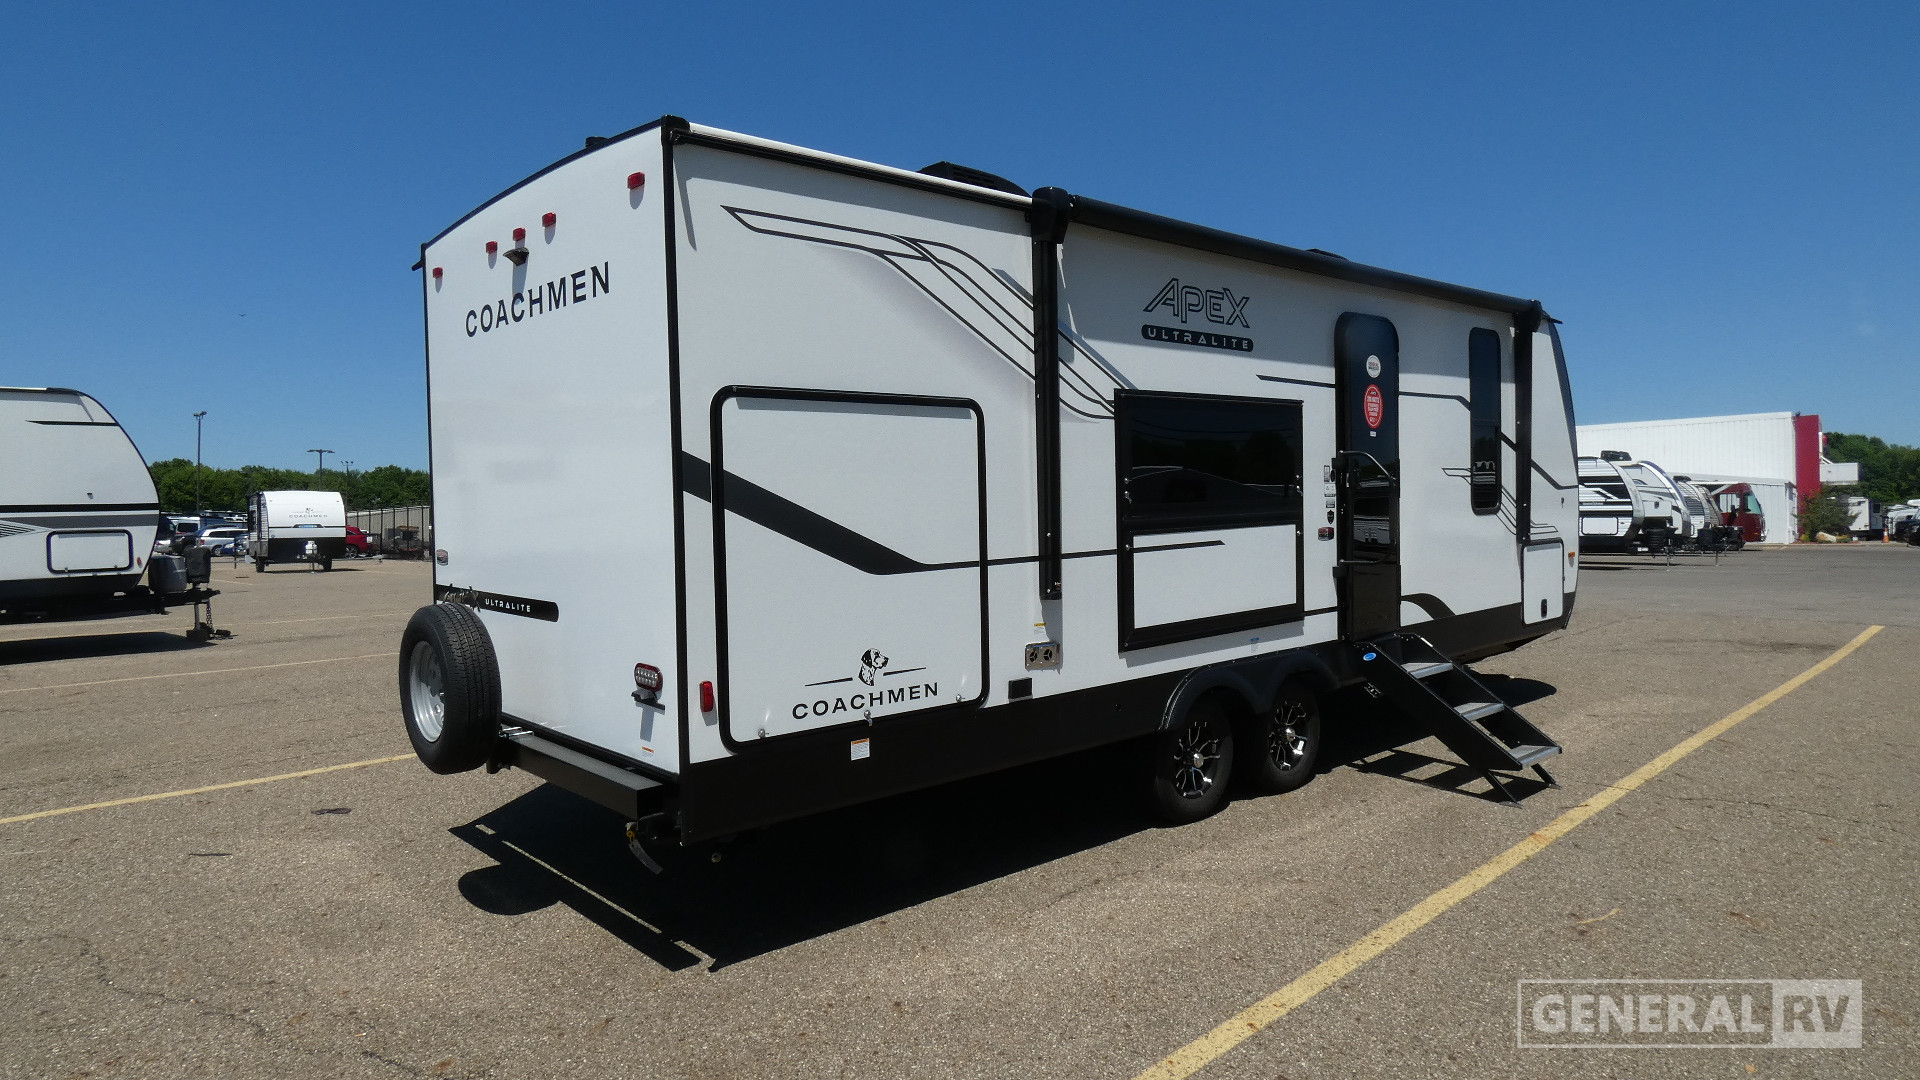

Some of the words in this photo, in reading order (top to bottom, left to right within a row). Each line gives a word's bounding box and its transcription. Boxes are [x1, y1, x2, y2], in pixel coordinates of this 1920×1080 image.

[465, 261, 610, 338] COACHMEN
[1143, 277, 1250, 328] APEX
[1147, 327, 1249, 350] ULTRALITE
[484, 598, 532, 613] ULTRALITE
[792, 682, 939, 720] COACHMEN
